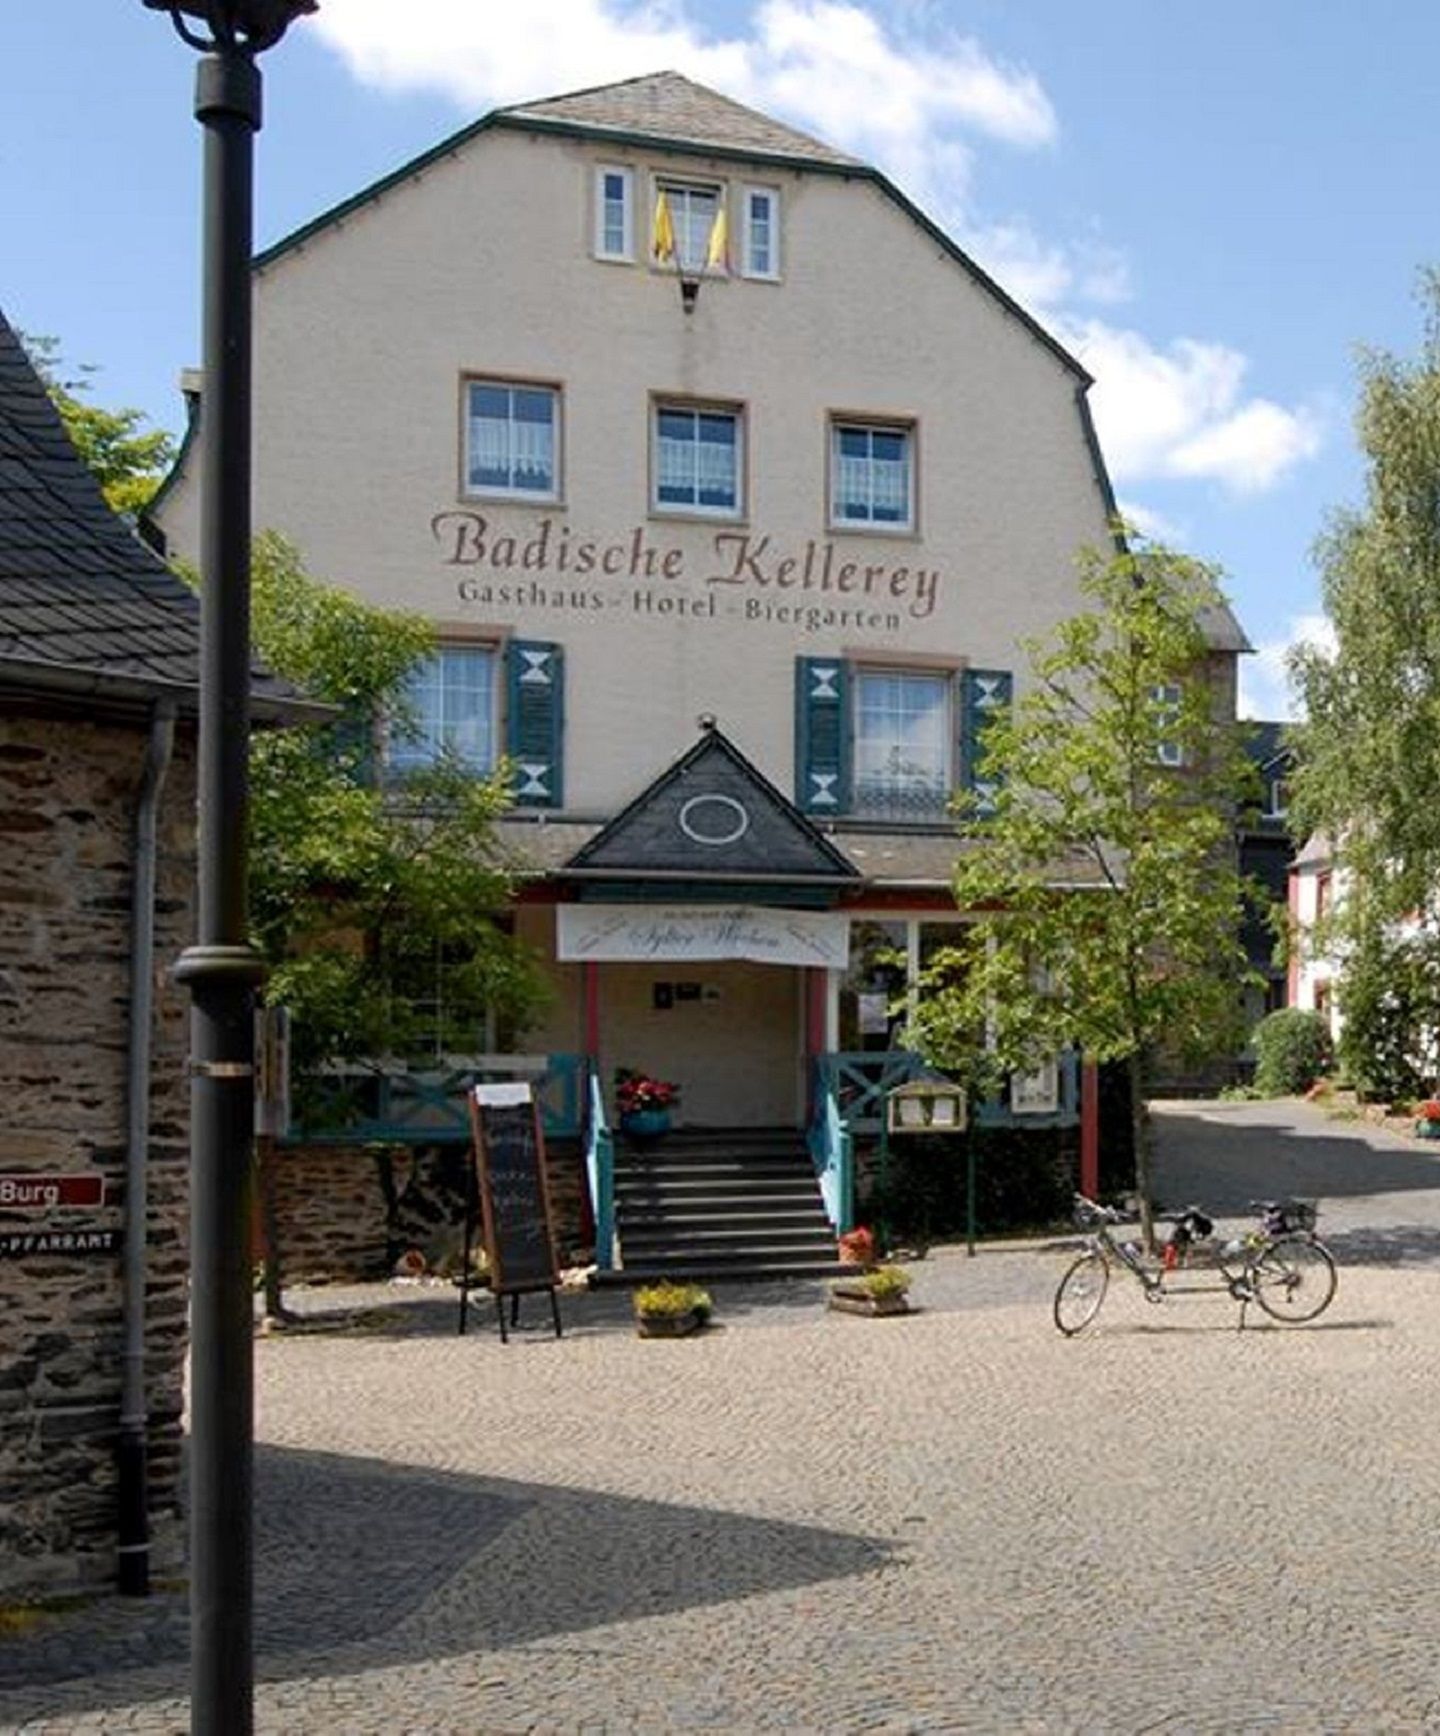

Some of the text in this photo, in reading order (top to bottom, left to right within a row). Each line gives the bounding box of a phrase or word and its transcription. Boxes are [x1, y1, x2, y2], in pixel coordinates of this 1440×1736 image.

[430, 510, 942, 618] Badische Kellerey
[458, 579, 901, 632] Gasthaus Hotel Biergarten
[0, 1181, 60, 1207] Burg
